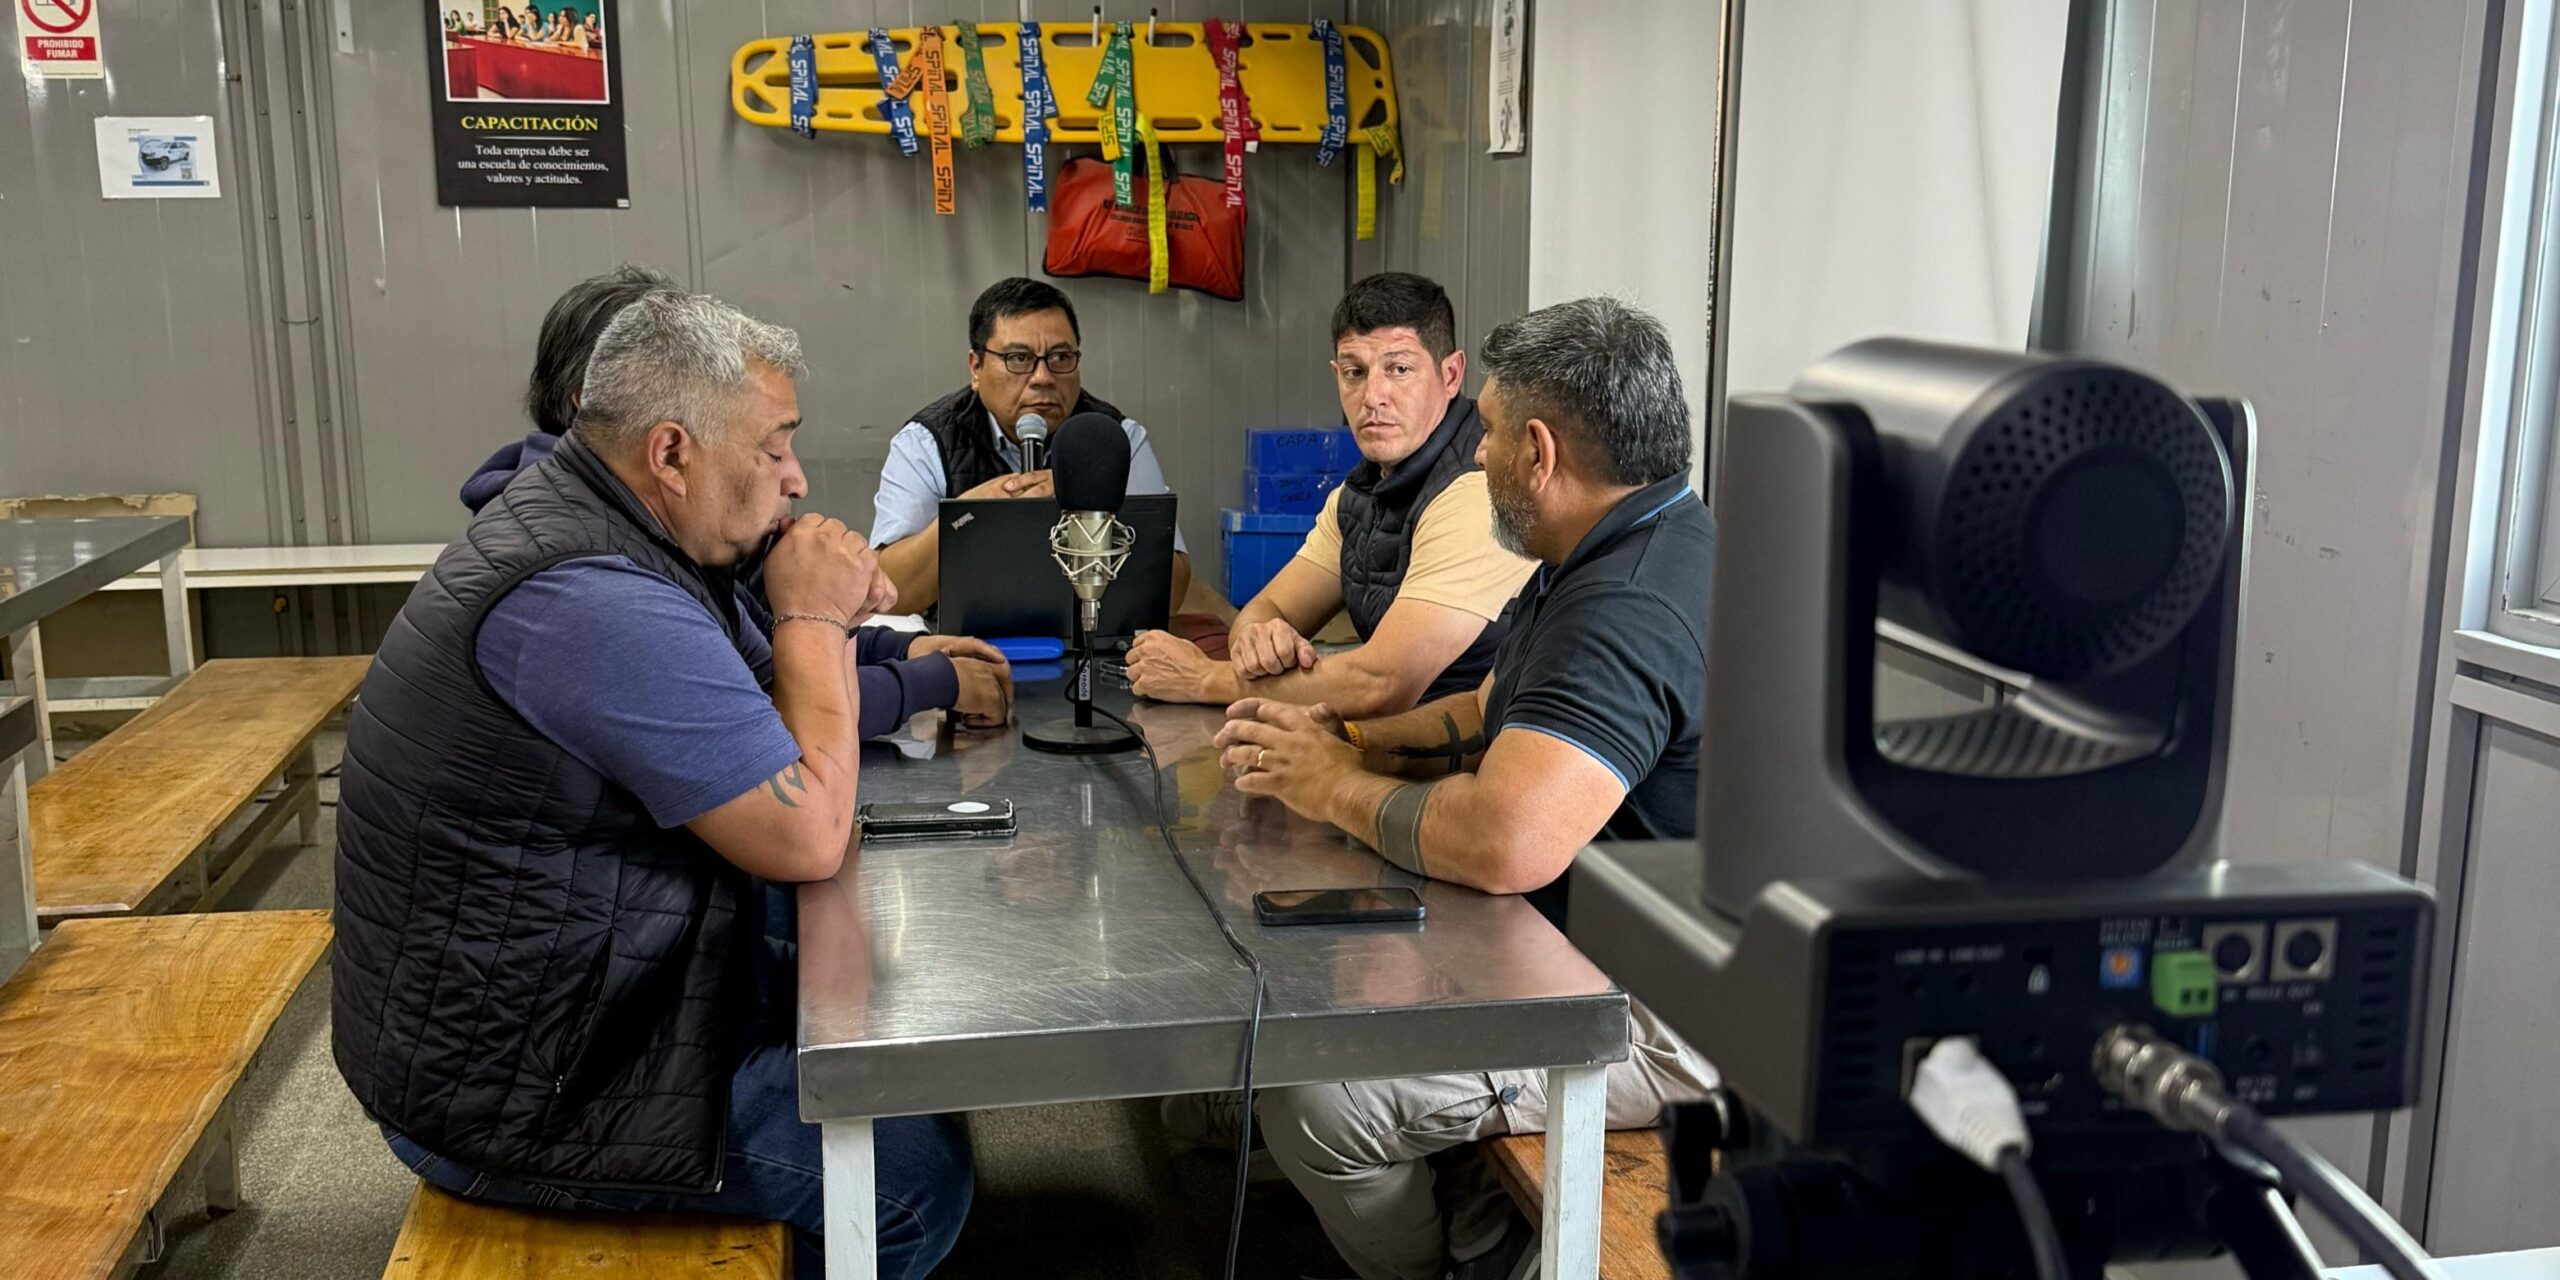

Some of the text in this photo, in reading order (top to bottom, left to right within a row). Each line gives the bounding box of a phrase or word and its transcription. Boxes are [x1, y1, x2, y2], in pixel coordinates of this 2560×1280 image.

[37, 39, 84, 48] PROHIBIDO
[46, 49, 78, 58] FUMAR
[461, 115, 598, 131] CAPACITACIÓN
[475, 145, 501, 156] Toda
[504, 147, 546, 158] empresa
[548, 146, 572, 156] debe
[458, 160, 609, 171] una escuela de conocimientos,
[486, 173, 583, 185] valores y actitudes.
[1276, 433, 1318, 448] CAPA
